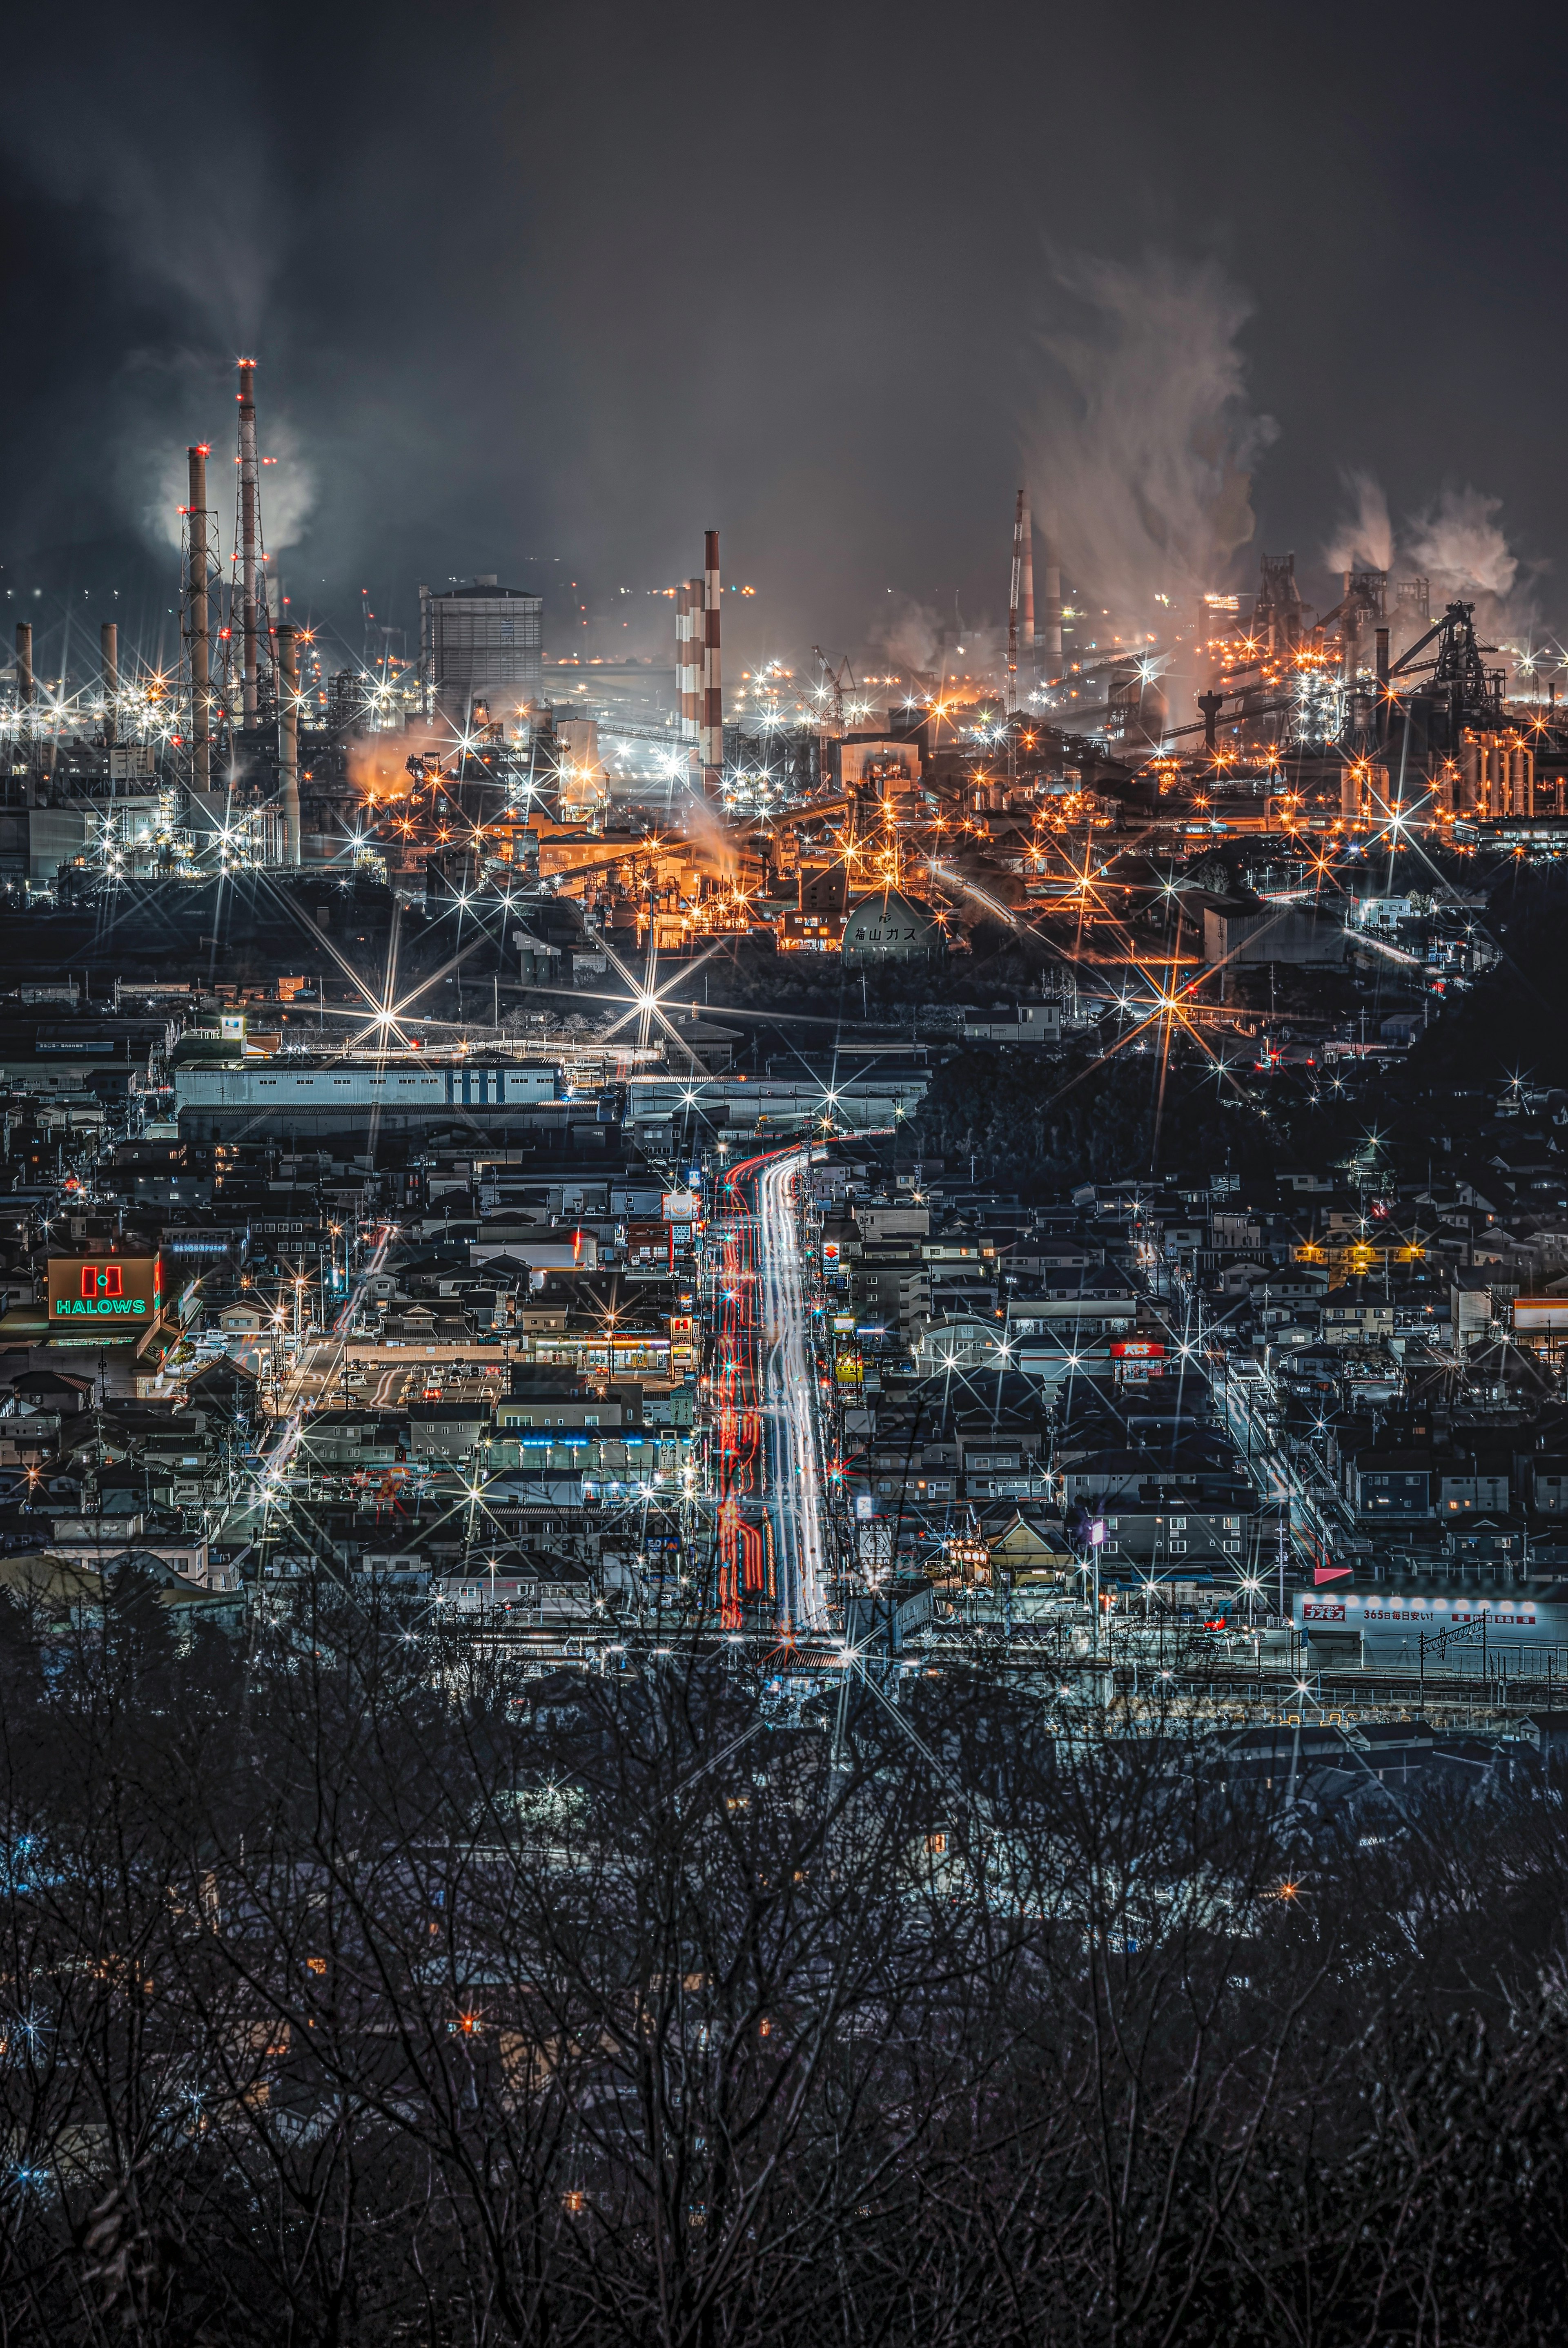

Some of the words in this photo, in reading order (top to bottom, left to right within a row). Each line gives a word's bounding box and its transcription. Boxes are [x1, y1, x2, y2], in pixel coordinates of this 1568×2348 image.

[855, 928, 916, 940] 福山ガス
[57, 1300, 145, 1314] HALOWS
[1305, 1610, 1344, 1619] コスモス
[1364, 1610, 1433, 1621] 365日毎日安い!
